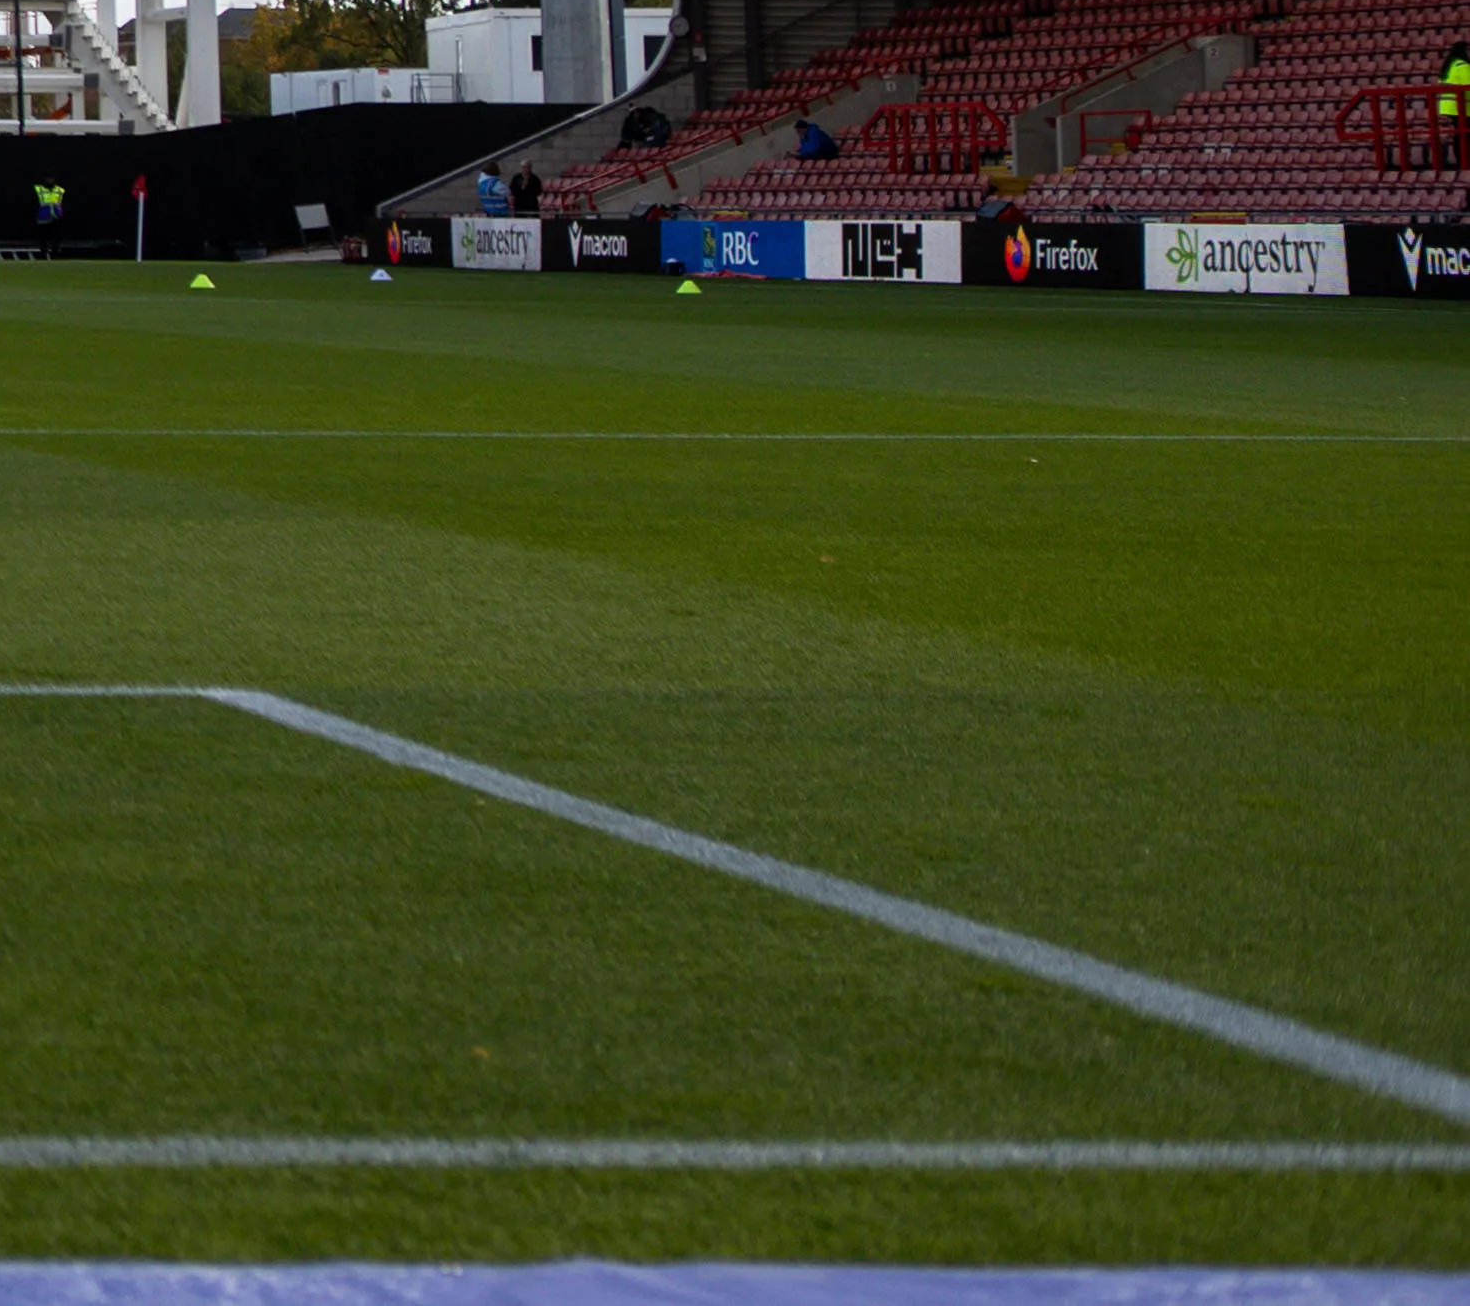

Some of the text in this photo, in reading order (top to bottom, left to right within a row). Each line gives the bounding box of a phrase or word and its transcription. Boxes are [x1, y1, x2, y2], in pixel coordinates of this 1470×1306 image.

[401, 230, 432, 255] Firefox
[475, 225, 530, 259] ancestry
[582, 235, 628, 258] macron
[722, 231, 759, 266] RBC
[1035, 238, 1099, 272] Firefox
[1203, 233, 1321, 288] ancestry
